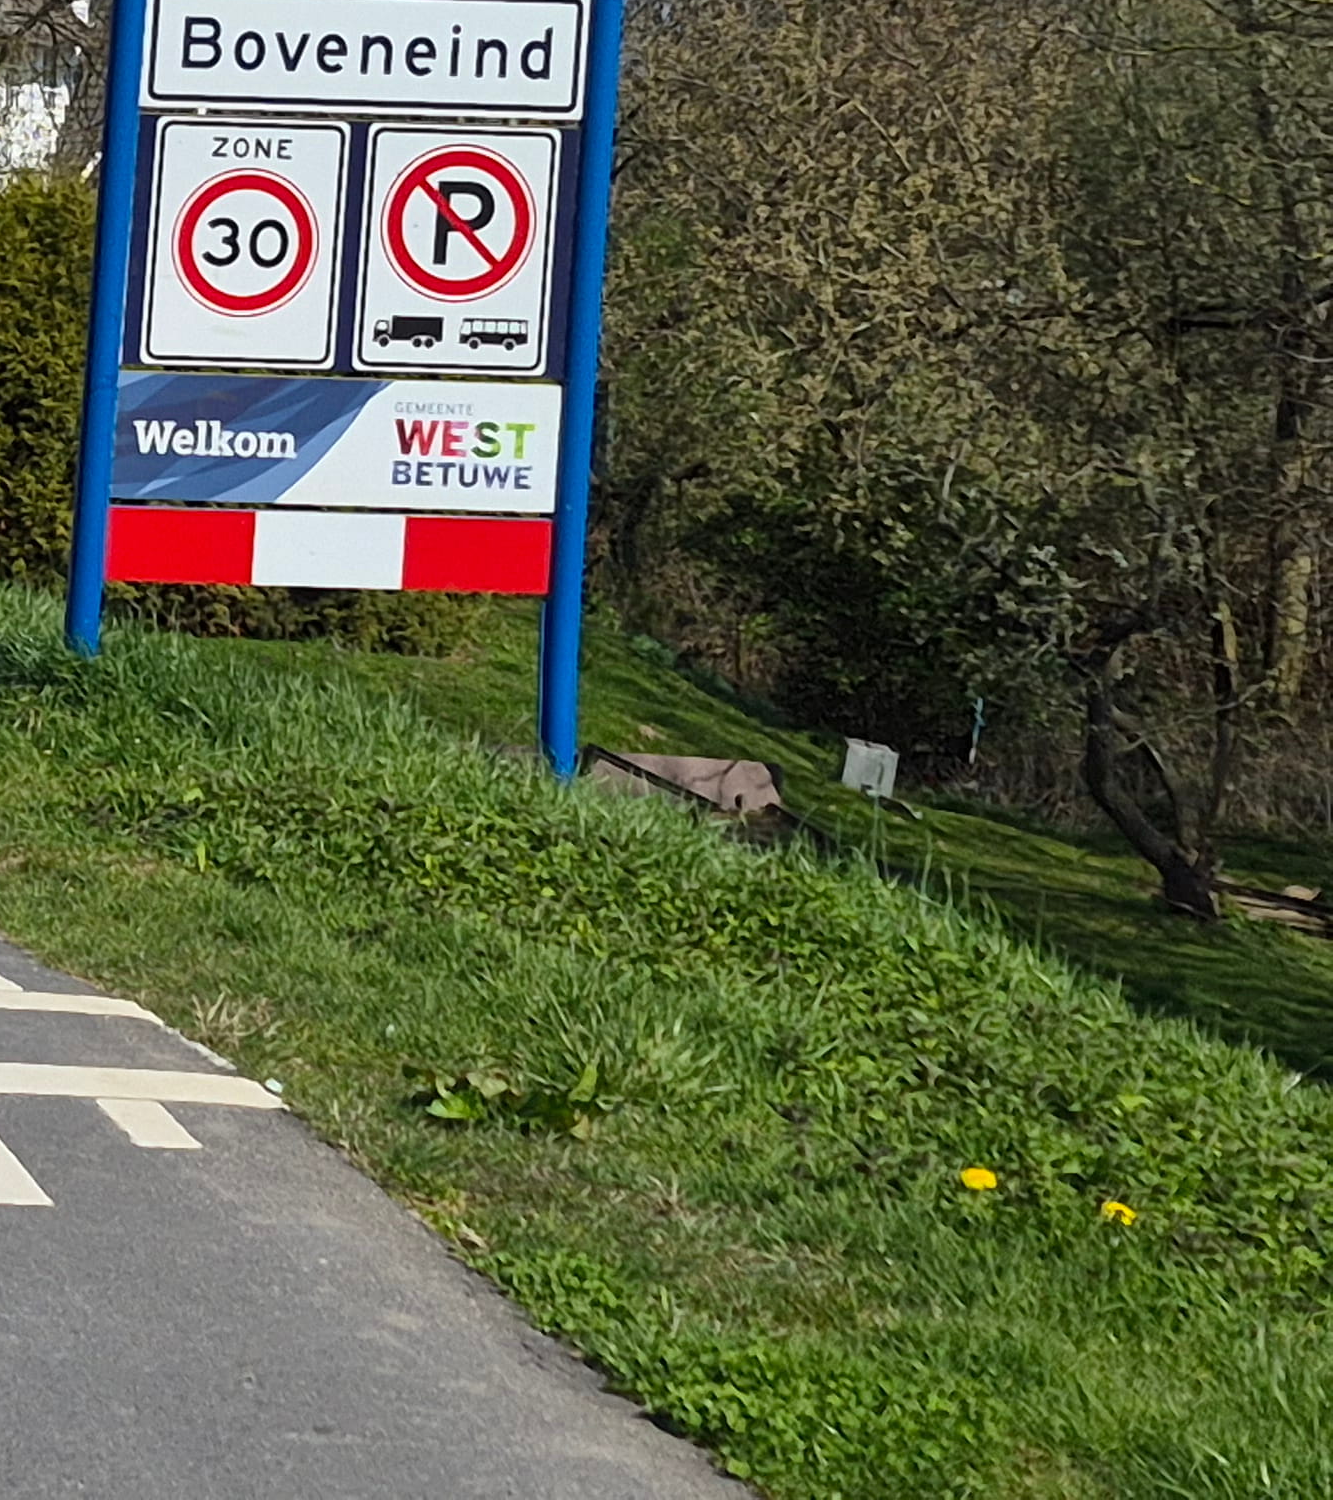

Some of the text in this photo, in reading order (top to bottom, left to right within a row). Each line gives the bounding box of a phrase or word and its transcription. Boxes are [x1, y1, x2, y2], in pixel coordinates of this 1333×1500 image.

[181, 15, 555, 81] Boveneind
[211, 137, 294, 160] ZONE
[201, 217, 290, 269] 30
[393, 401, 475, 416] GEMEENTE
[133, 419, 298, 460] Welkom
[394, 418, 537, 459] WEST
[391, 460, 533, 490] BETUWE
